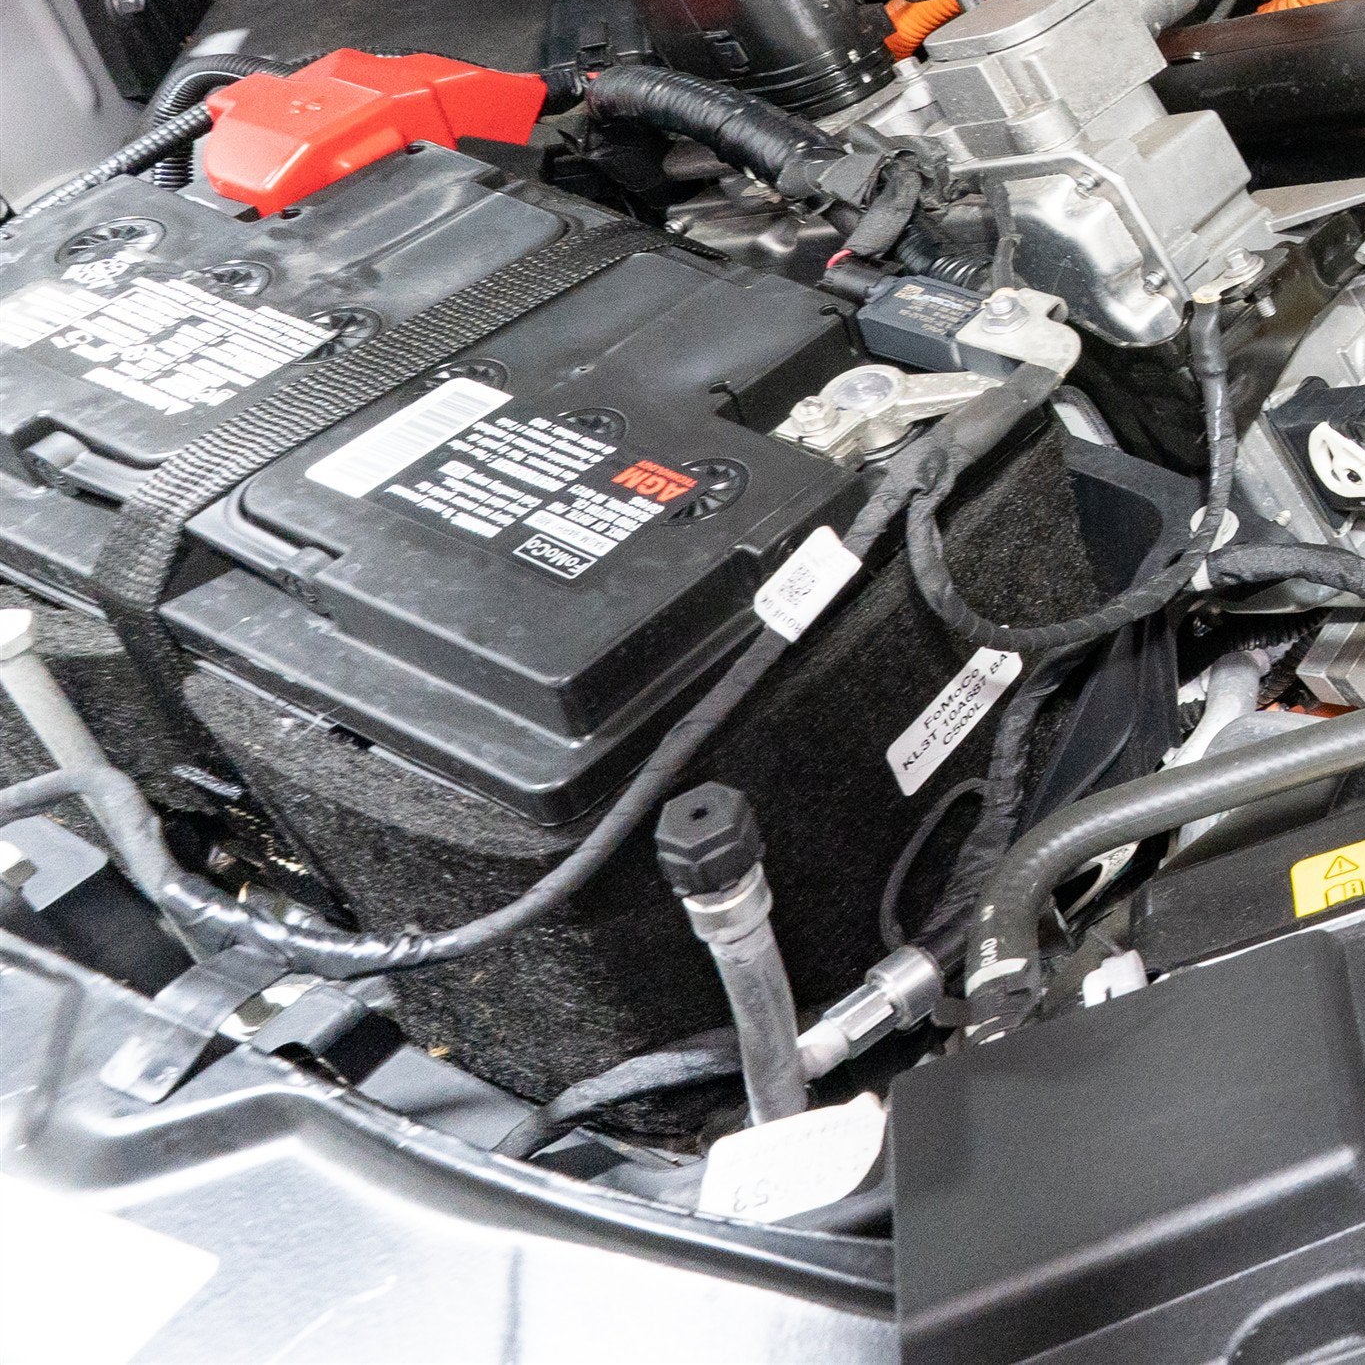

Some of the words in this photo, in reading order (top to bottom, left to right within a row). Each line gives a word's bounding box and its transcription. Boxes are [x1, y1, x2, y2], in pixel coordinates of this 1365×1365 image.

[609, 464, 687, 503] AGM
[525, 539, 589, 574] FoMoCo
[922, 666, 981, 731] FoMoCo
[941, 675, 989, 729] 10A687
[941, 700, 985, 747] C500L
